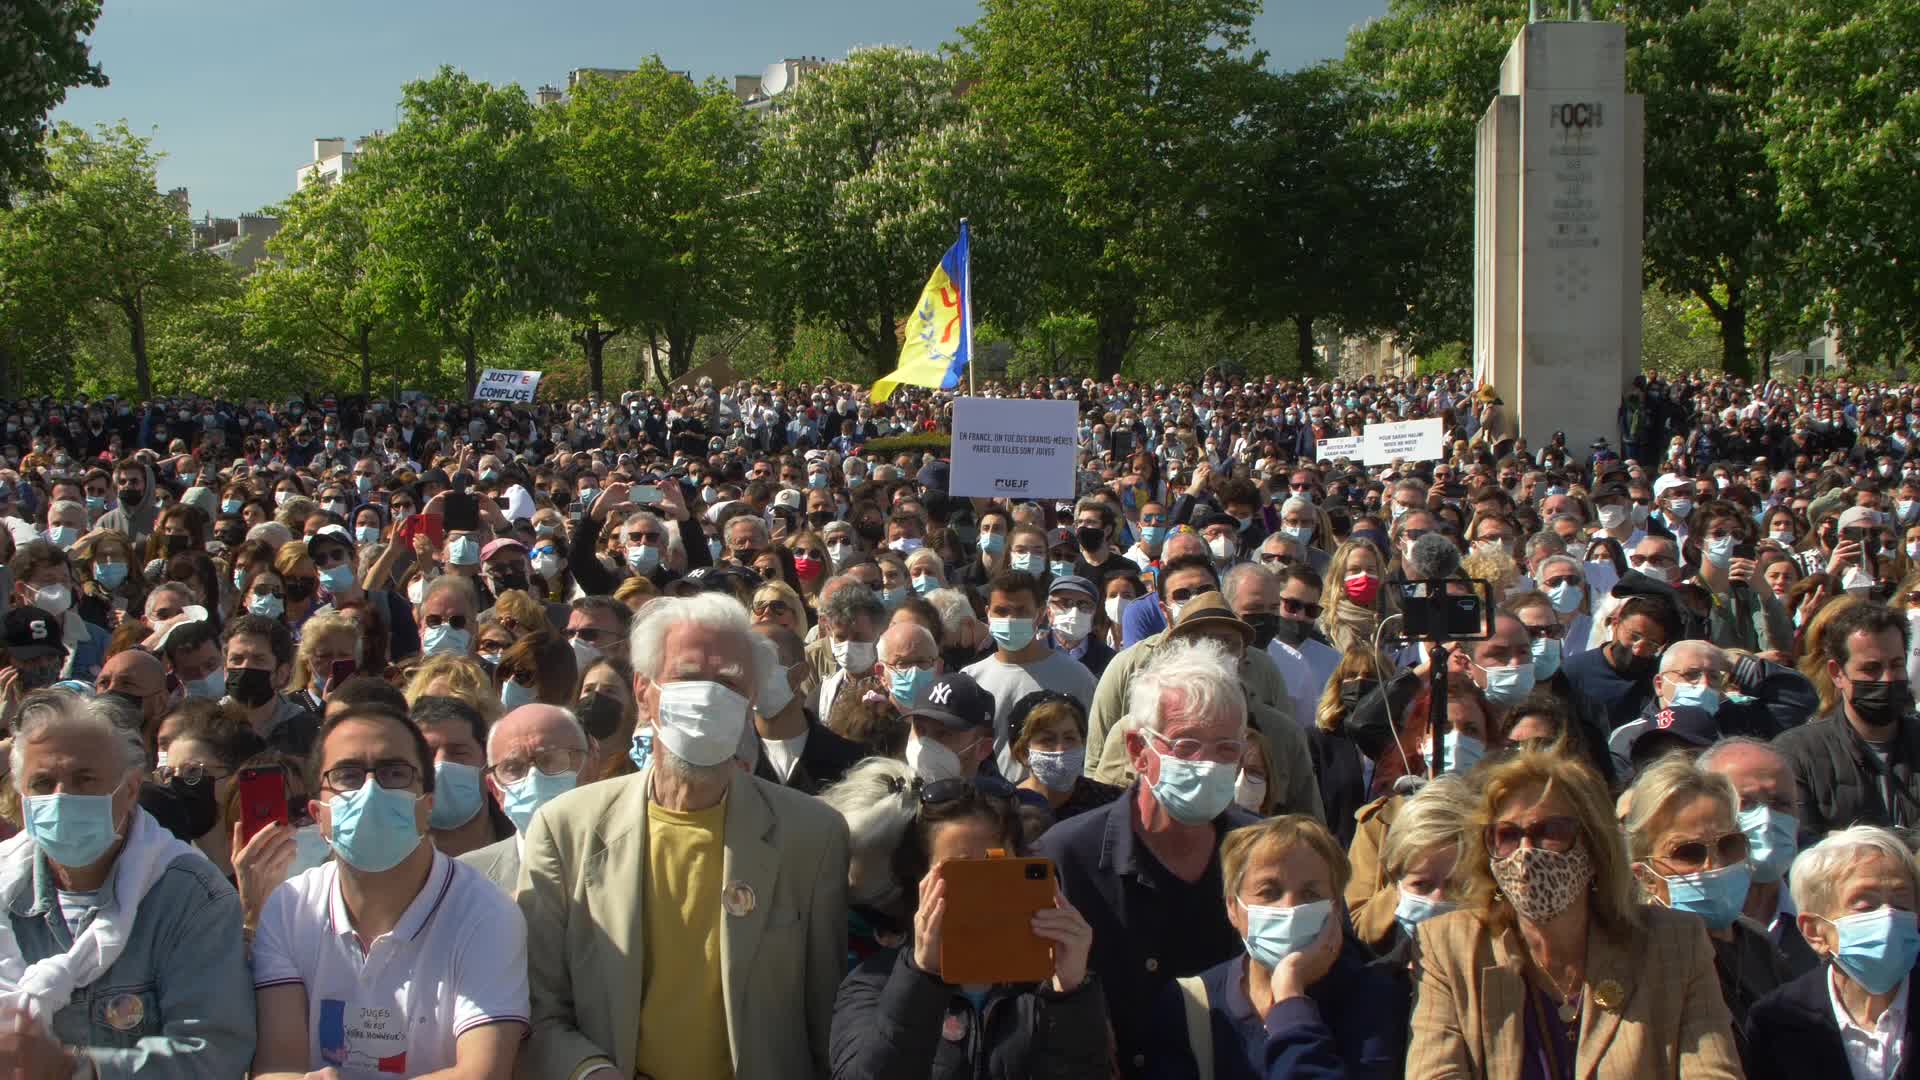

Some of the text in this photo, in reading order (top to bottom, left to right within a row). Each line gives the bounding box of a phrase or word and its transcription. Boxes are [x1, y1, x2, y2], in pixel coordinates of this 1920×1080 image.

[1550, 103, 1602, 128] FOCH
[479, 387, 530, 400] COMPLICE
[1005, 479, 1029, 488] UEJF
